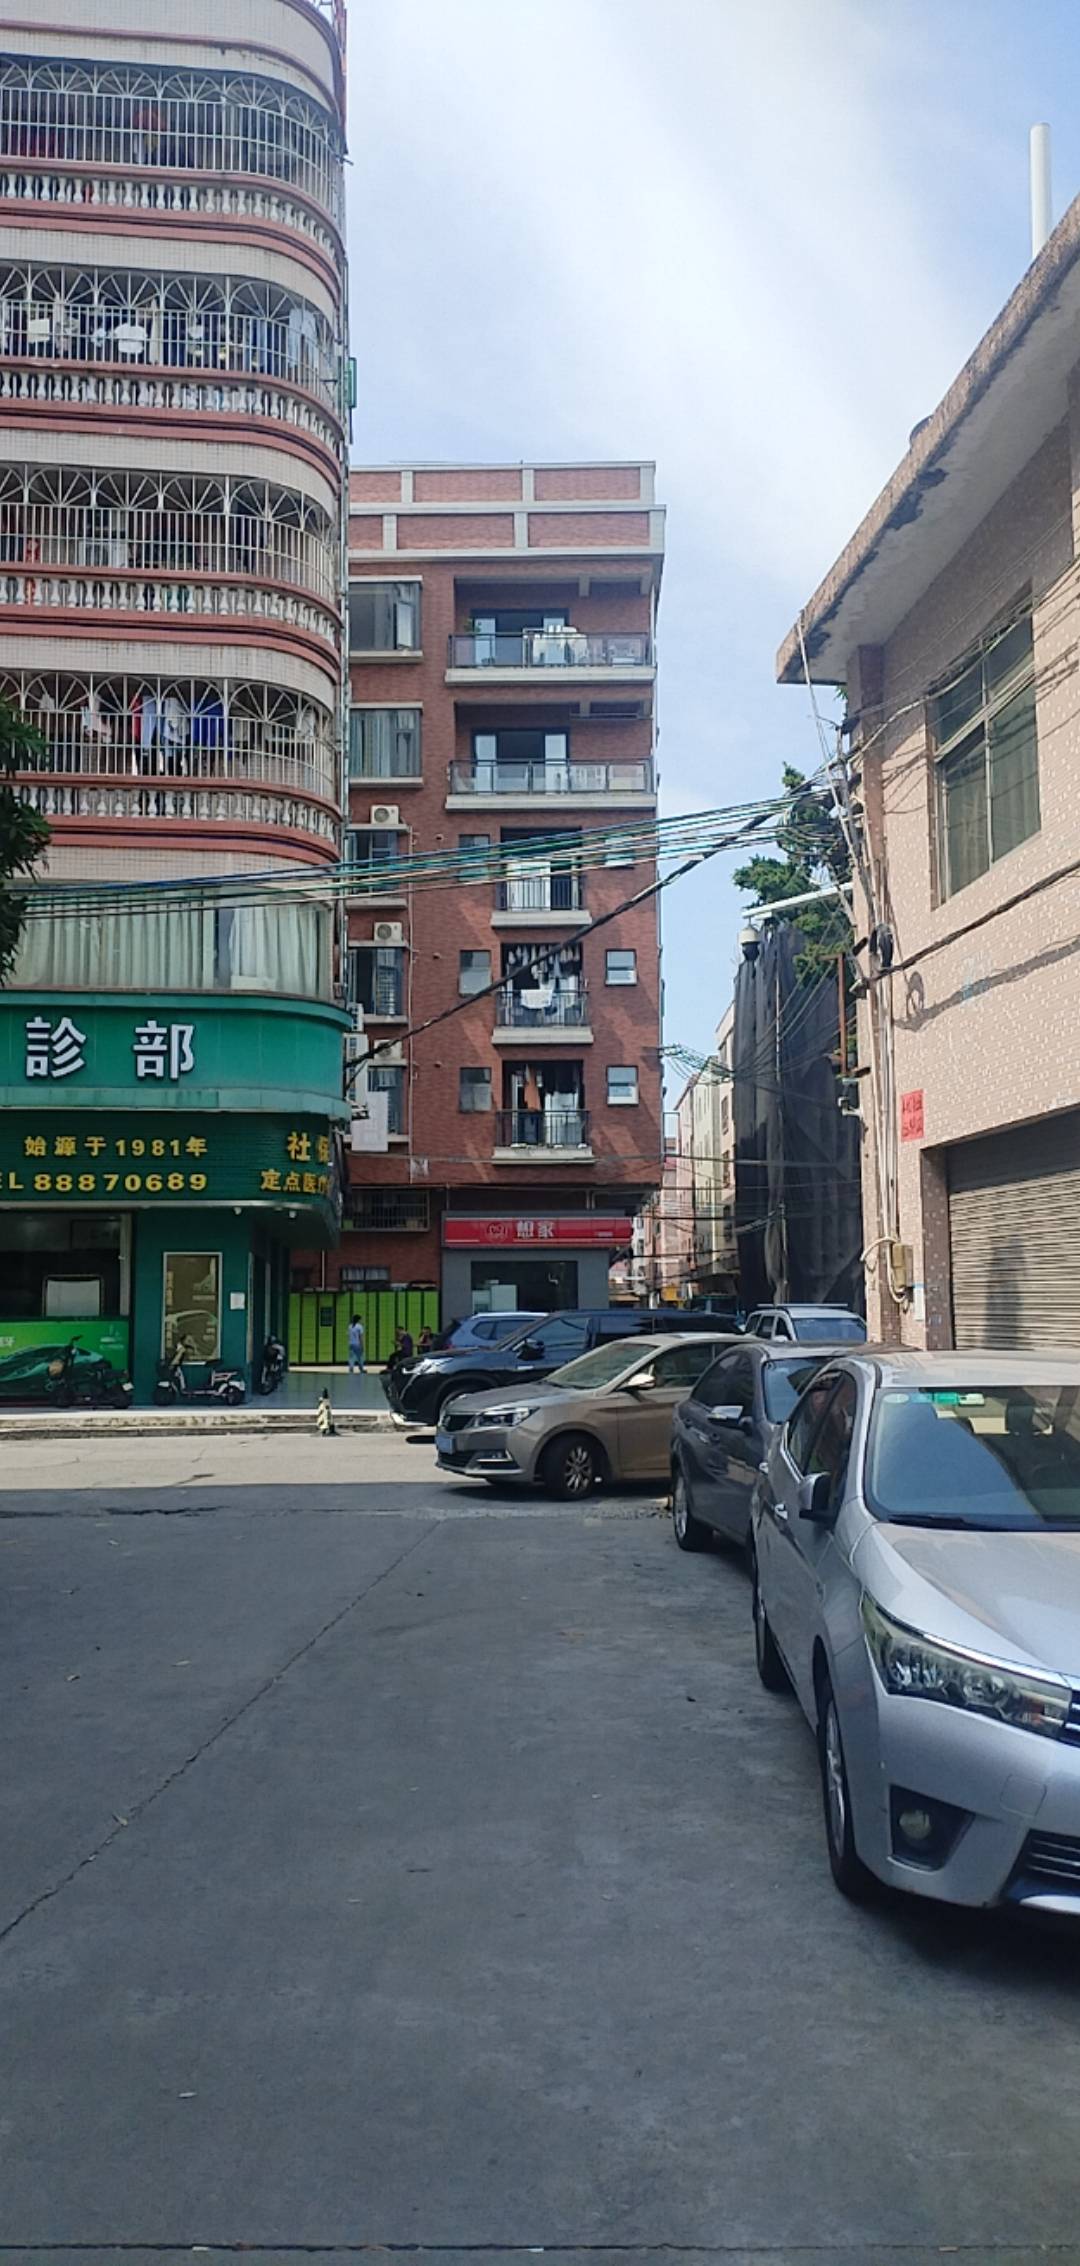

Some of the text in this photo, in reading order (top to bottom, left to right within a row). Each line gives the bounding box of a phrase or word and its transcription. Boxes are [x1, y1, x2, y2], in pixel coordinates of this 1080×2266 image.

[25, 1016, 195, 1079] 診部
[24, 1136, 208, 1157] 始源于1981年
[0, 1172, 207, 1191] L 88870689
